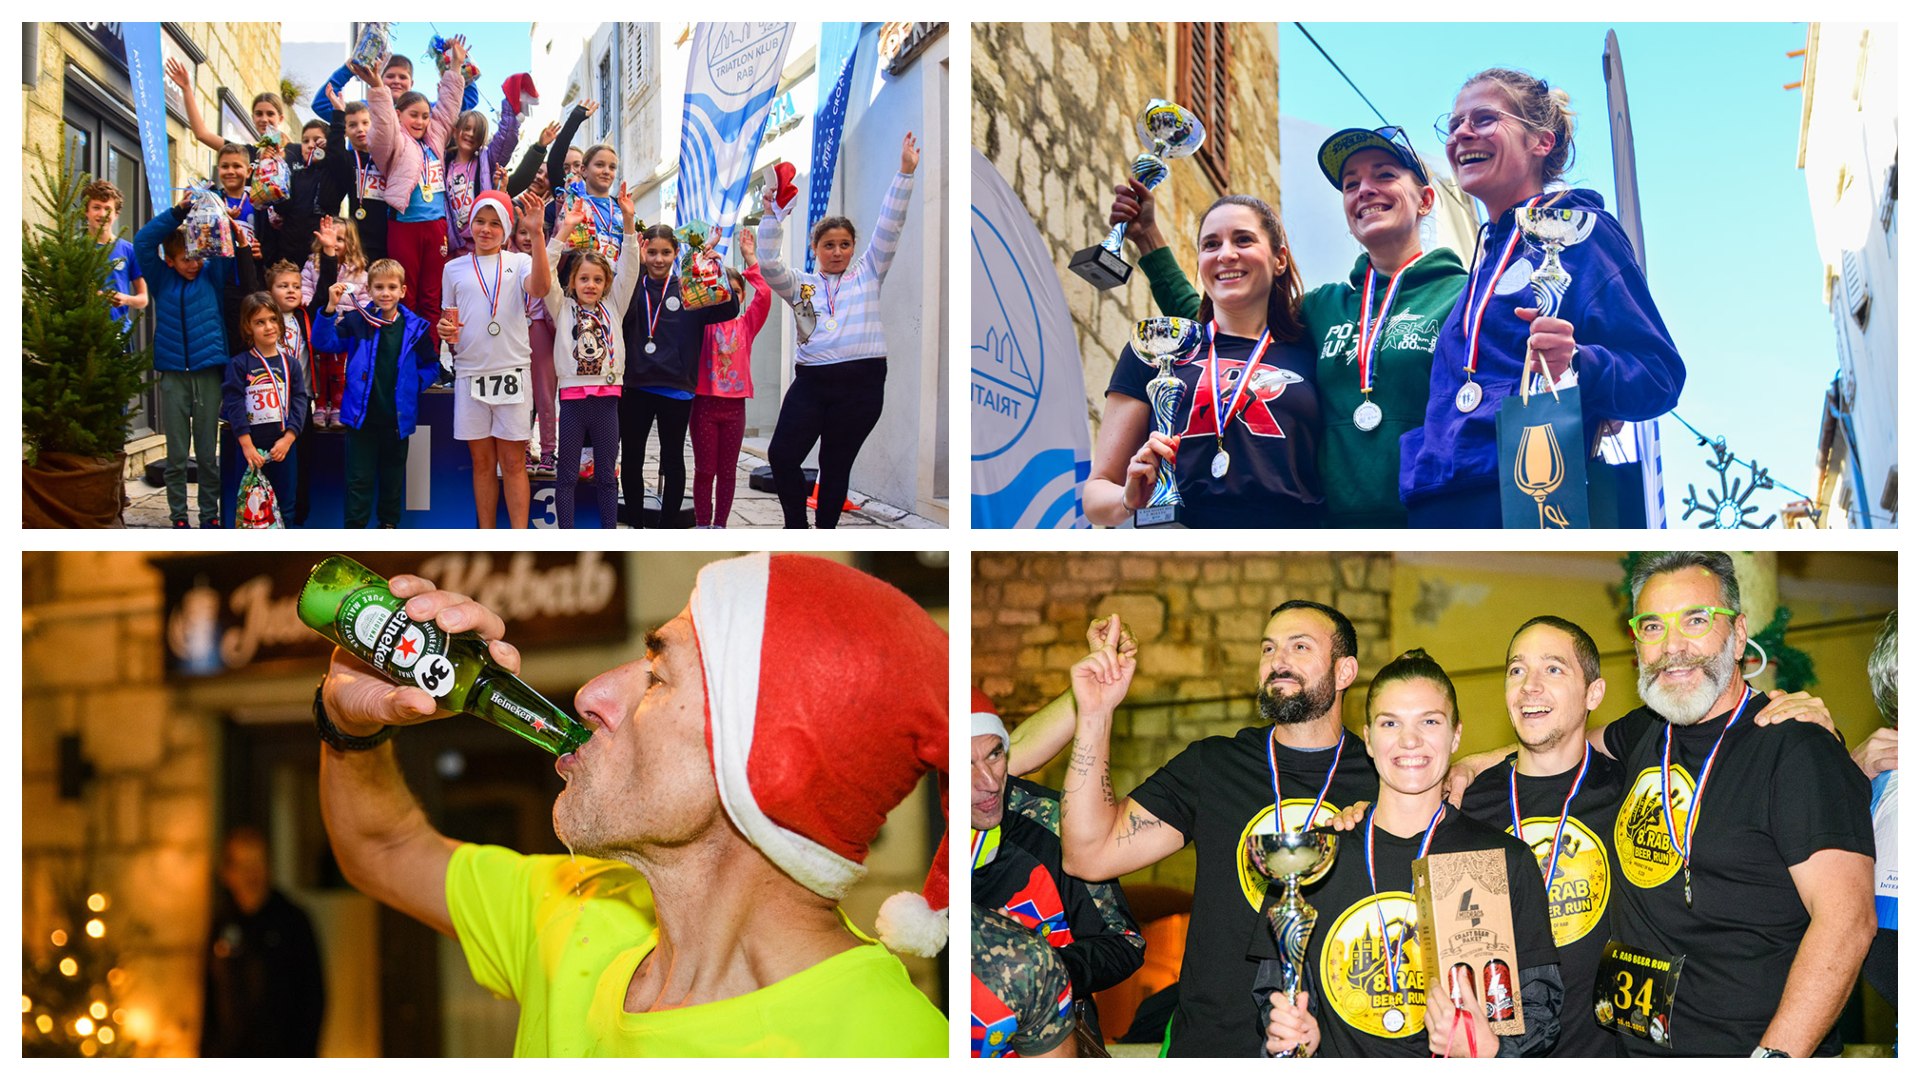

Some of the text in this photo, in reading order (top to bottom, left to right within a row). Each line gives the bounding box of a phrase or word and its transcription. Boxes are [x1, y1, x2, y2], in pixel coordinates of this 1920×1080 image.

[716, 38, 779, 78] TRIATLON KLUB
[736, 66, 754, 82] RAB
[823, 127, 835, 169] RIJEKA
[475, 374, 519, 397] 178
[252, 391, 280, 411] 30
[344, 593, 384, 648] PURE MALT LAGER
[373, 605, 408, 670] eineken
[421, 658, 450, 691] 39
[490, 692, 532, 722] Heineken
[1636, 830, 1671, 851] 8. RAB
[1634, 847, 1670, 865] BEER RUN
[1549, 880, 1590, 903] RAB
[1565, 899, 1591, 915] RUN
[1619, 951, 1633, 962] RAB
[1632, 954, 1651, 968] BEER
[1651, 958, 1671, 972] RUN
[1614, 970, 1654, 1017] 34
